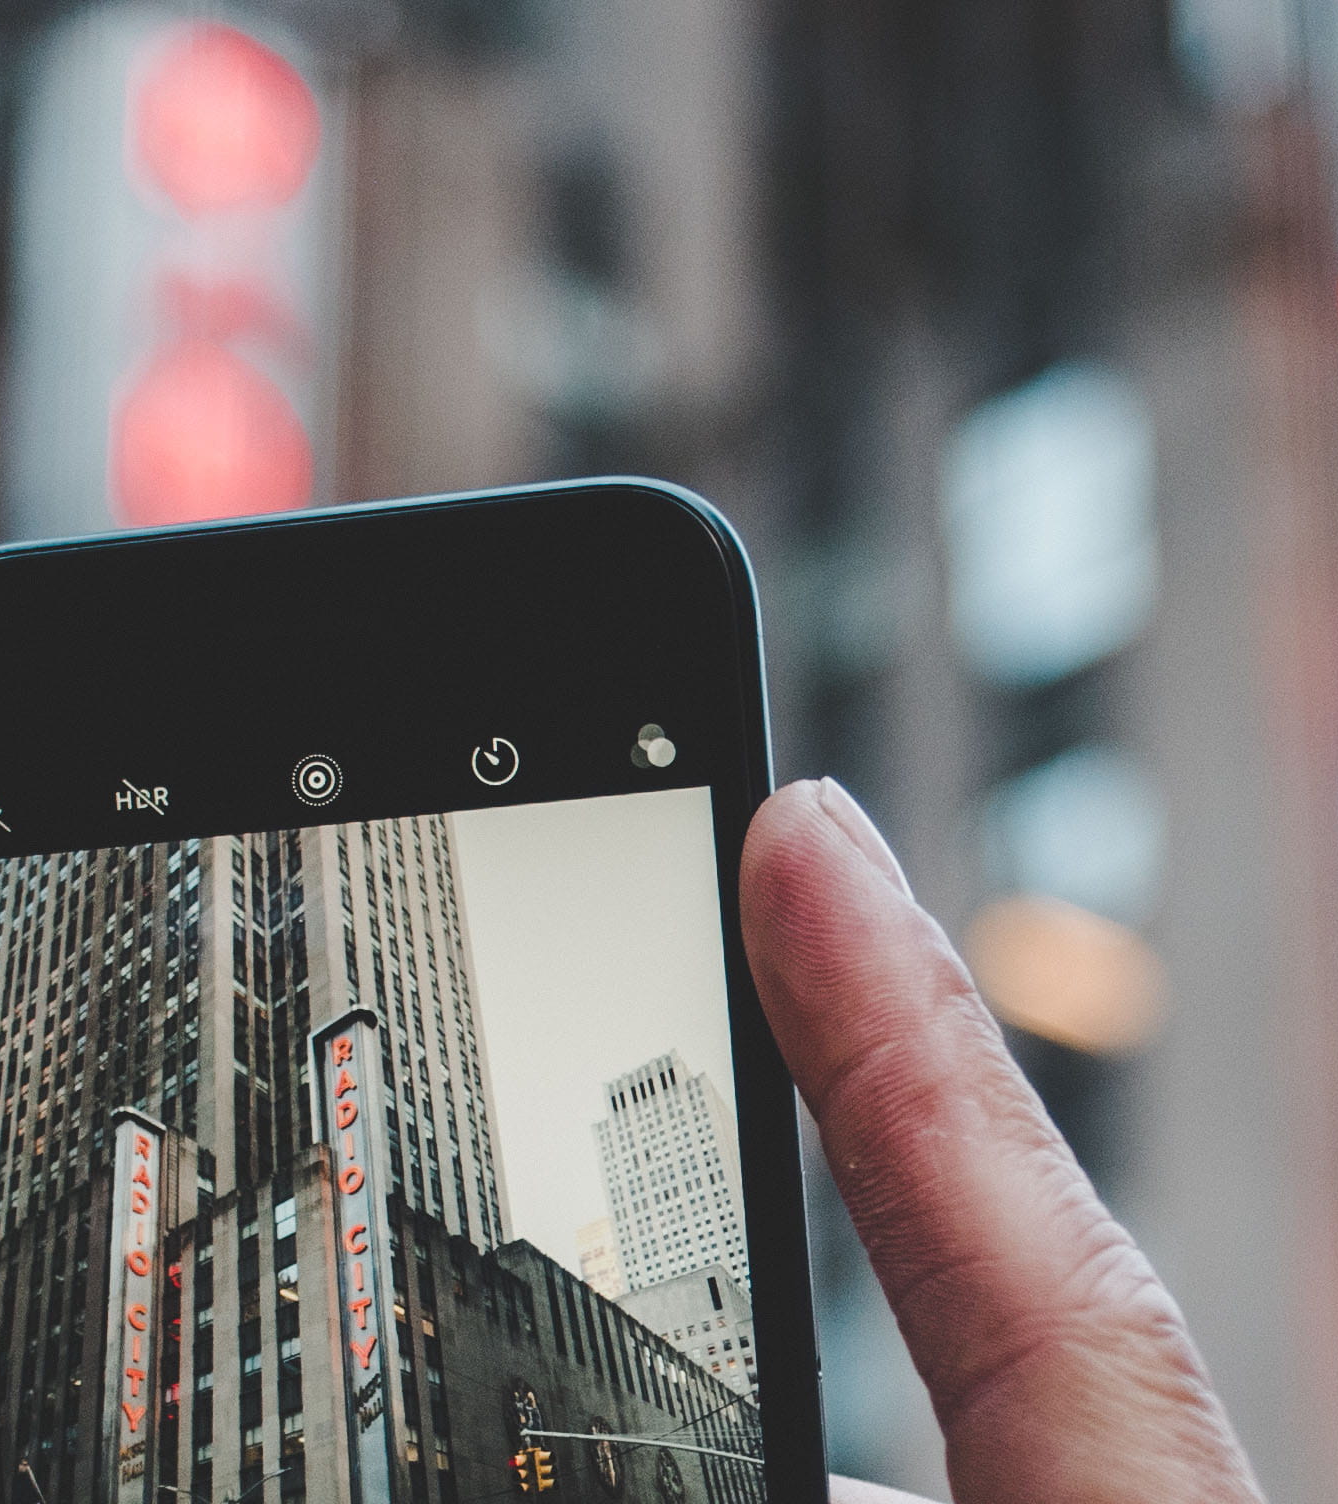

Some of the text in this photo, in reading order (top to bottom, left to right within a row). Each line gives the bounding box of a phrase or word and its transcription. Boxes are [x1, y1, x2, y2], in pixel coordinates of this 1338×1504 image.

[122, 1133, 152, 1433] RADIO CITY
[332, 1037, 378, 1368] RADIO CITY
